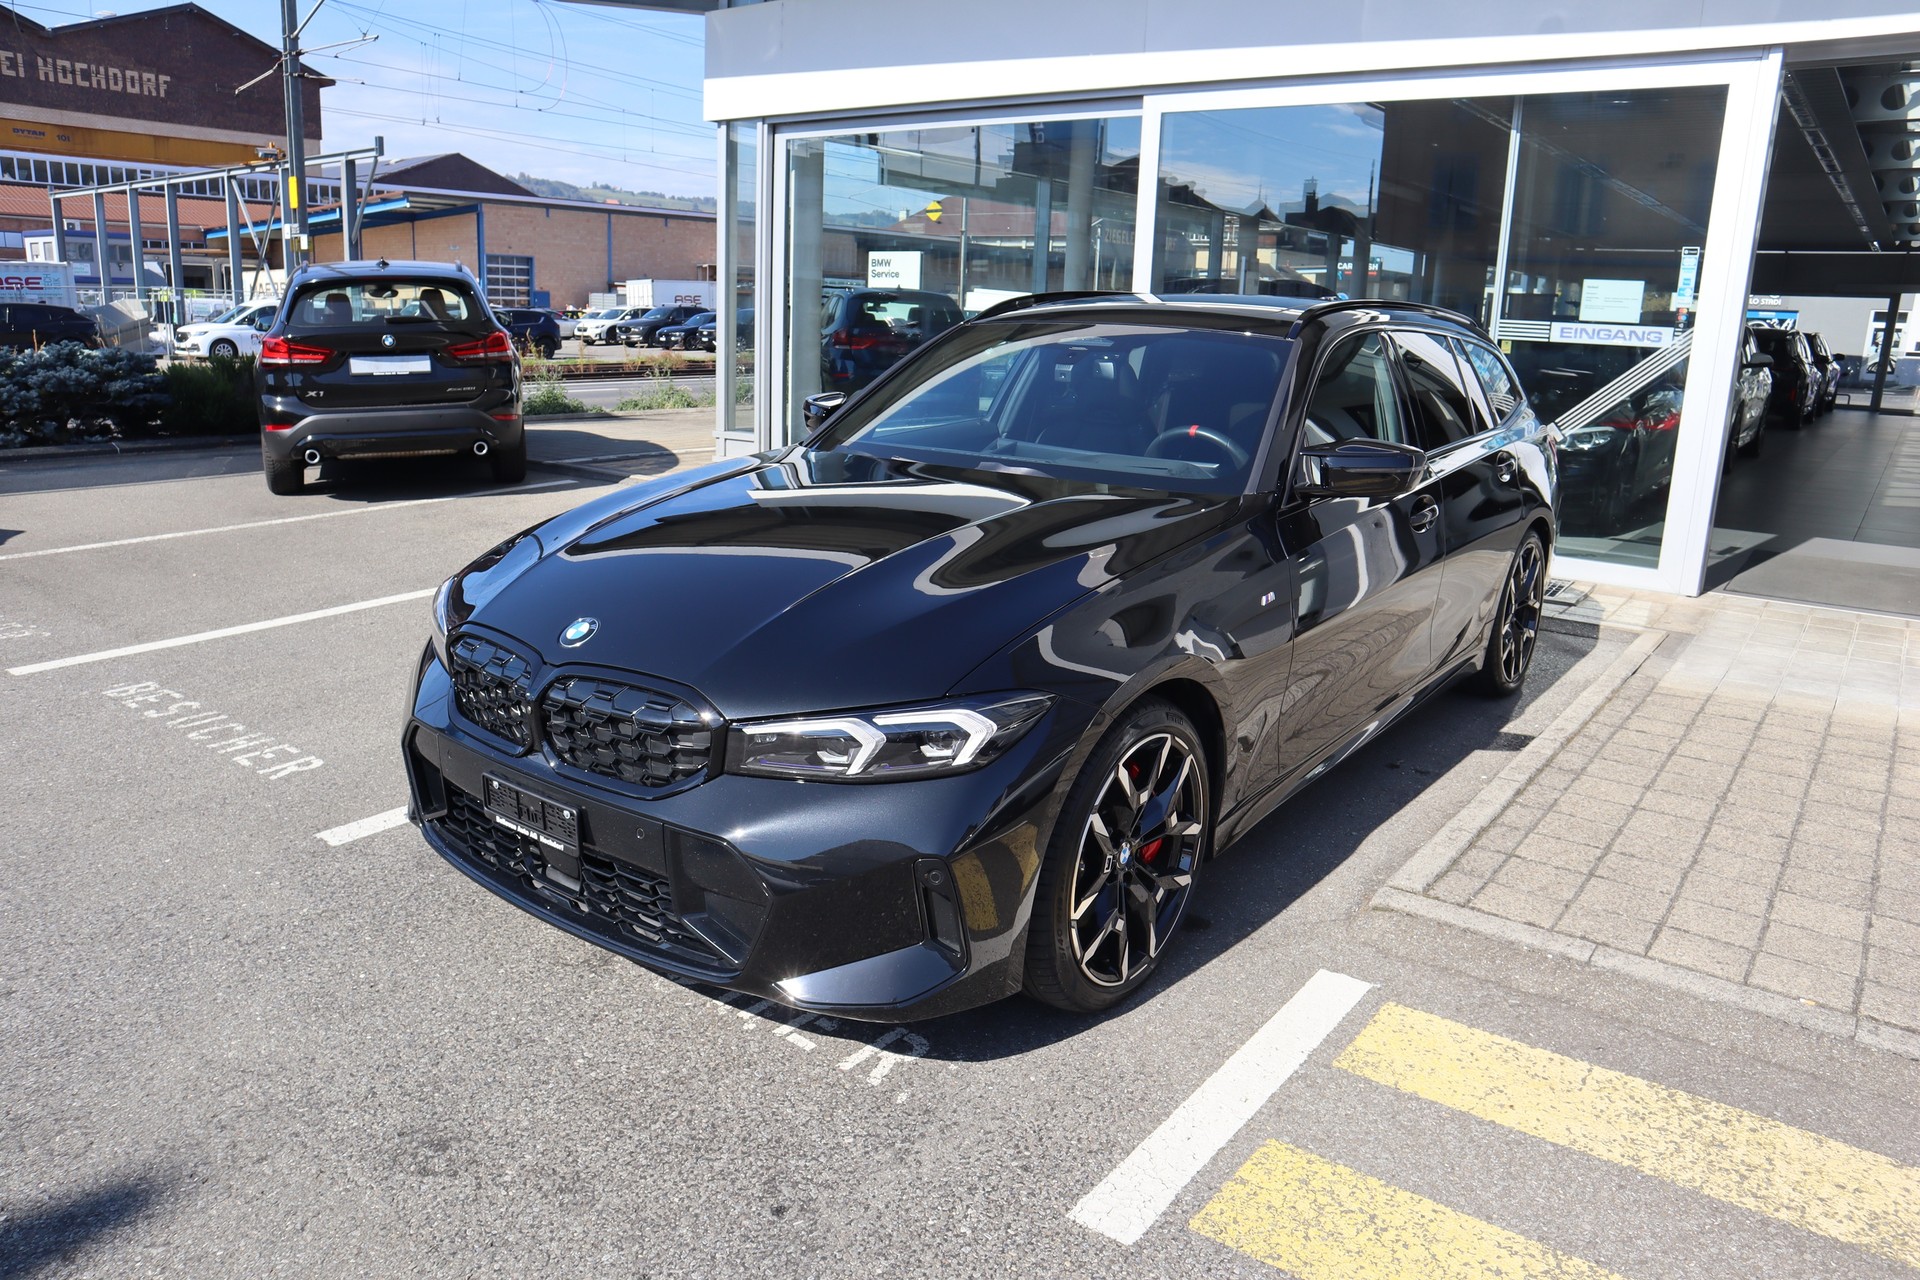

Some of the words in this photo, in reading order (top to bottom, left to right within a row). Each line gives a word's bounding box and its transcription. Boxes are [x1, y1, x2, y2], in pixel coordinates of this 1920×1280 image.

[36, 57, 171, 98] HOCHDORF
[871, 258, 892, 267] BMW
[1337, 262, 1353, 270] CAR
[871, 269, 900, 278] Service
[0, 276, 43, 290] SE
[674, 295, 702, 305] ASE
[1559, 327, 1663, 343] EINGANG
[305, 390, 325, 398] X1
